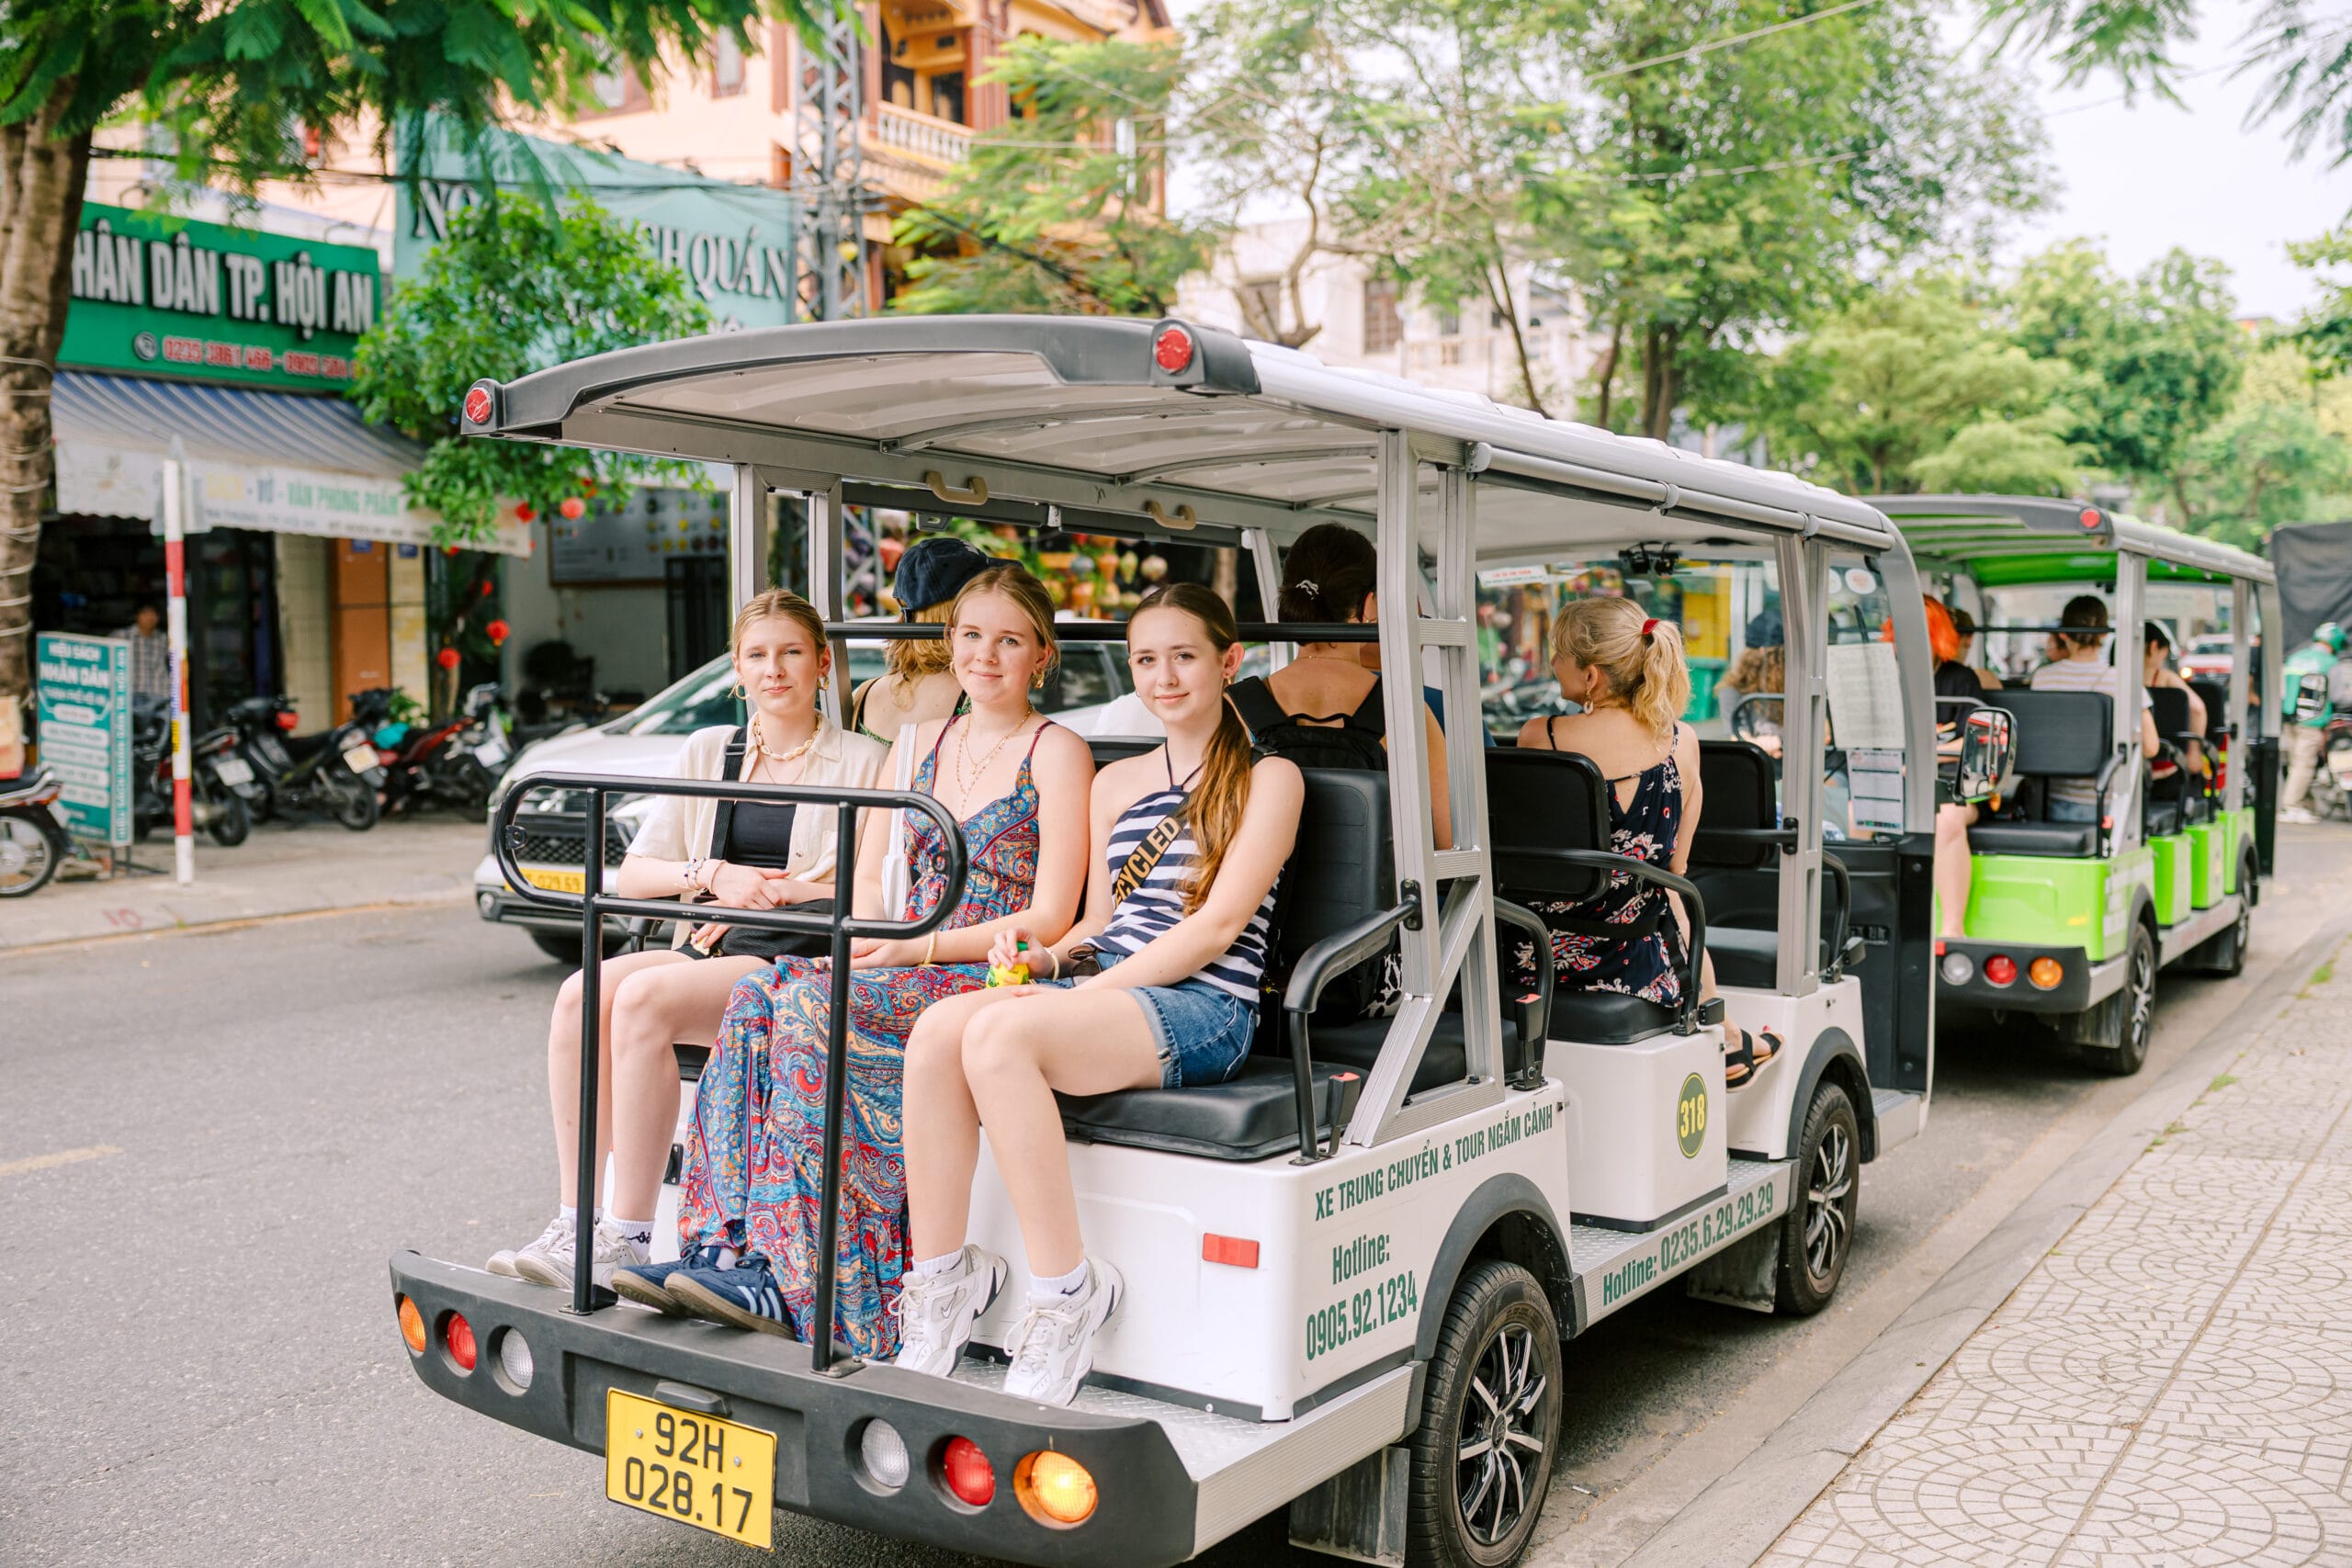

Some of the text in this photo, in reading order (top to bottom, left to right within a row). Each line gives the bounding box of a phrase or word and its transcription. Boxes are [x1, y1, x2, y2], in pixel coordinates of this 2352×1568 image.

[72, 218, 373, 340] HÂN DÂN TP. HỘI AN
[690, 226, 788, 302] QUÁN
[1114, 817, 1181, 909] ECYCLED
[1679, 1093, 1705, 1139] 318
[1315, 1187, 1333, 1222] XE
[1339, 1168, 1384, 1212] TRUNG
[1387, 1139, 1439, 1191] CHUYỂN
[1442, 1144, 1452, 1170] &
[1454, 1130, 1485, 1165] TOUR
[1523, 1101, 1553, 1139] CẢNH
[1332, 1234, 1390, 1285] Hotline:
[1603, 1181, 1774, 1307] Hotline: 0235.6.29.29.29
[1306, 1270, 1418, 1361] 0905.92.1234
[654, 1411, 724, 1473] 92H
[625, 1456, 752, 1533] 028.17
